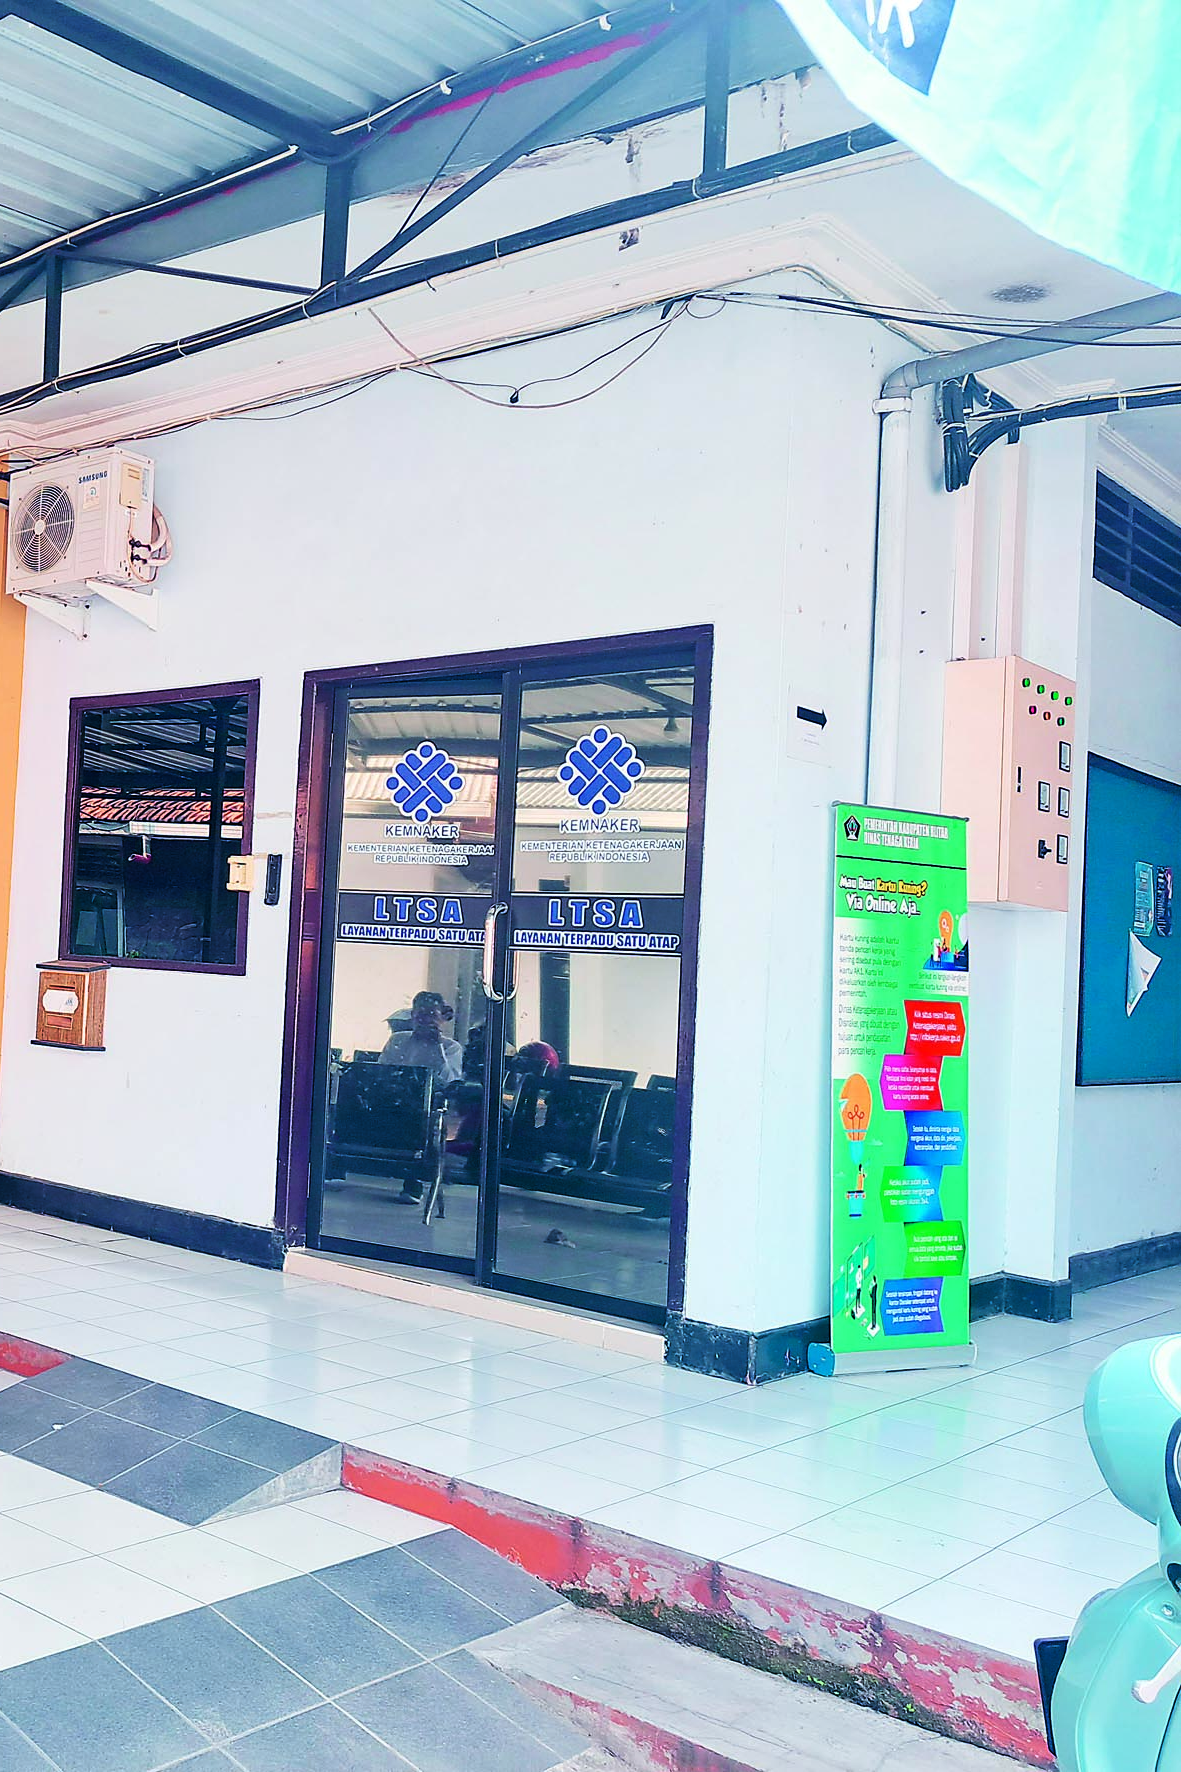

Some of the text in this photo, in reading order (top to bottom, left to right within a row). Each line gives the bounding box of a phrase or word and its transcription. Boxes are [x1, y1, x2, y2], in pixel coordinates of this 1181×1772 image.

[79, 471, 107, 484] SAMSUNG
[385, 824, 459, 838] KEMNAKER
[560, 818, 640, 832] KEMNAKER
[899, 821, 929, 836] KABUPATEN
[521, 839, 683, 851] KEMENTERIAN KETENAGAKERJAAN
[883, 834, 902, 847] TENAGA
[347, 844, 408, 854] KEMENTERIAN
[374, 854, 469, 865] REPUBLIK INDONESIA
[548, 851, 650, 862] REPUBLIK INDONESIA
[839, 875, 927, 897] Mau Buat Kartu Kuning?
[846, 893, 863, 911] Via
[866, 894, 896, 913] Online
[374, 897, 463, 924] LTSA
[548, 898, 643, 928] LTSA
[342, 926, 387, 938] LAYANAN
[387, 927, 437, 940] TERPADU
[438, 929, 466, 942] SATU
[514, 931, 680, 949] LAYANAN TERPADU SATU ATAP
